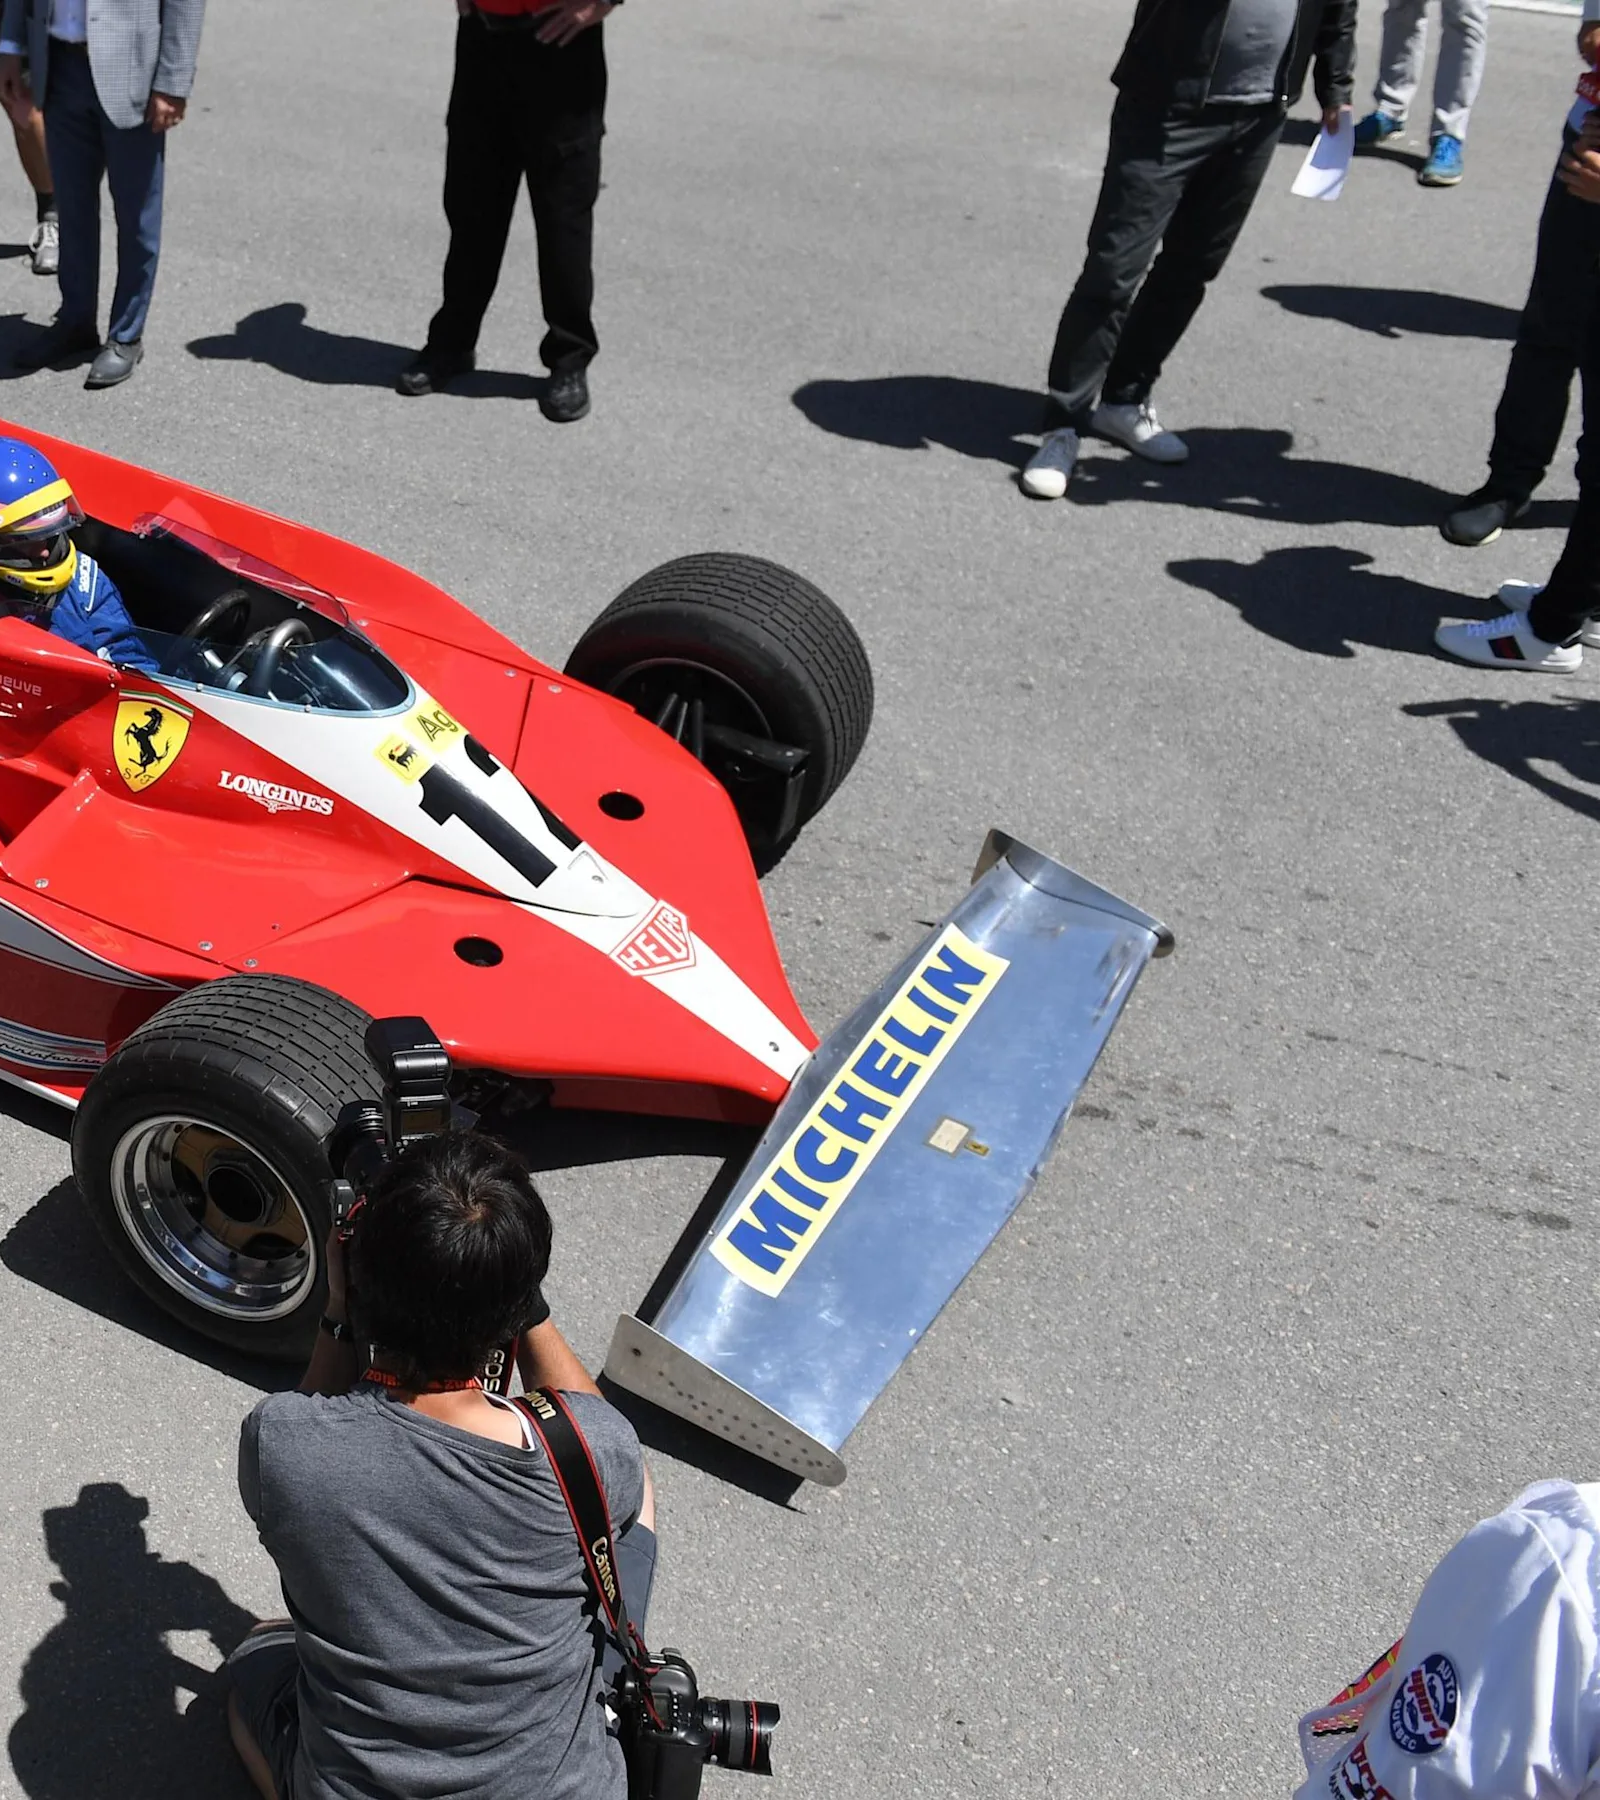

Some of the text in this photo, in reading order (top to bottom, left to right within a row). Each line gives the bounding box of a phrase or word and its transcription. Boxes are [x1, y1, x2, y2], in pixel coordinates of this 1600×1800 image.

[416, 709, 459, 742] Ag
[122, 766, 133, 781] S
[218, 770, 334, 816] LONGINES
[615, 905, 690, 970] HEUER
[725, 945, 989, 1276] MICHELIN
[591, 1536, 616, 1604] Canon
[1436, 1659, 1457, 1704] AUTO
